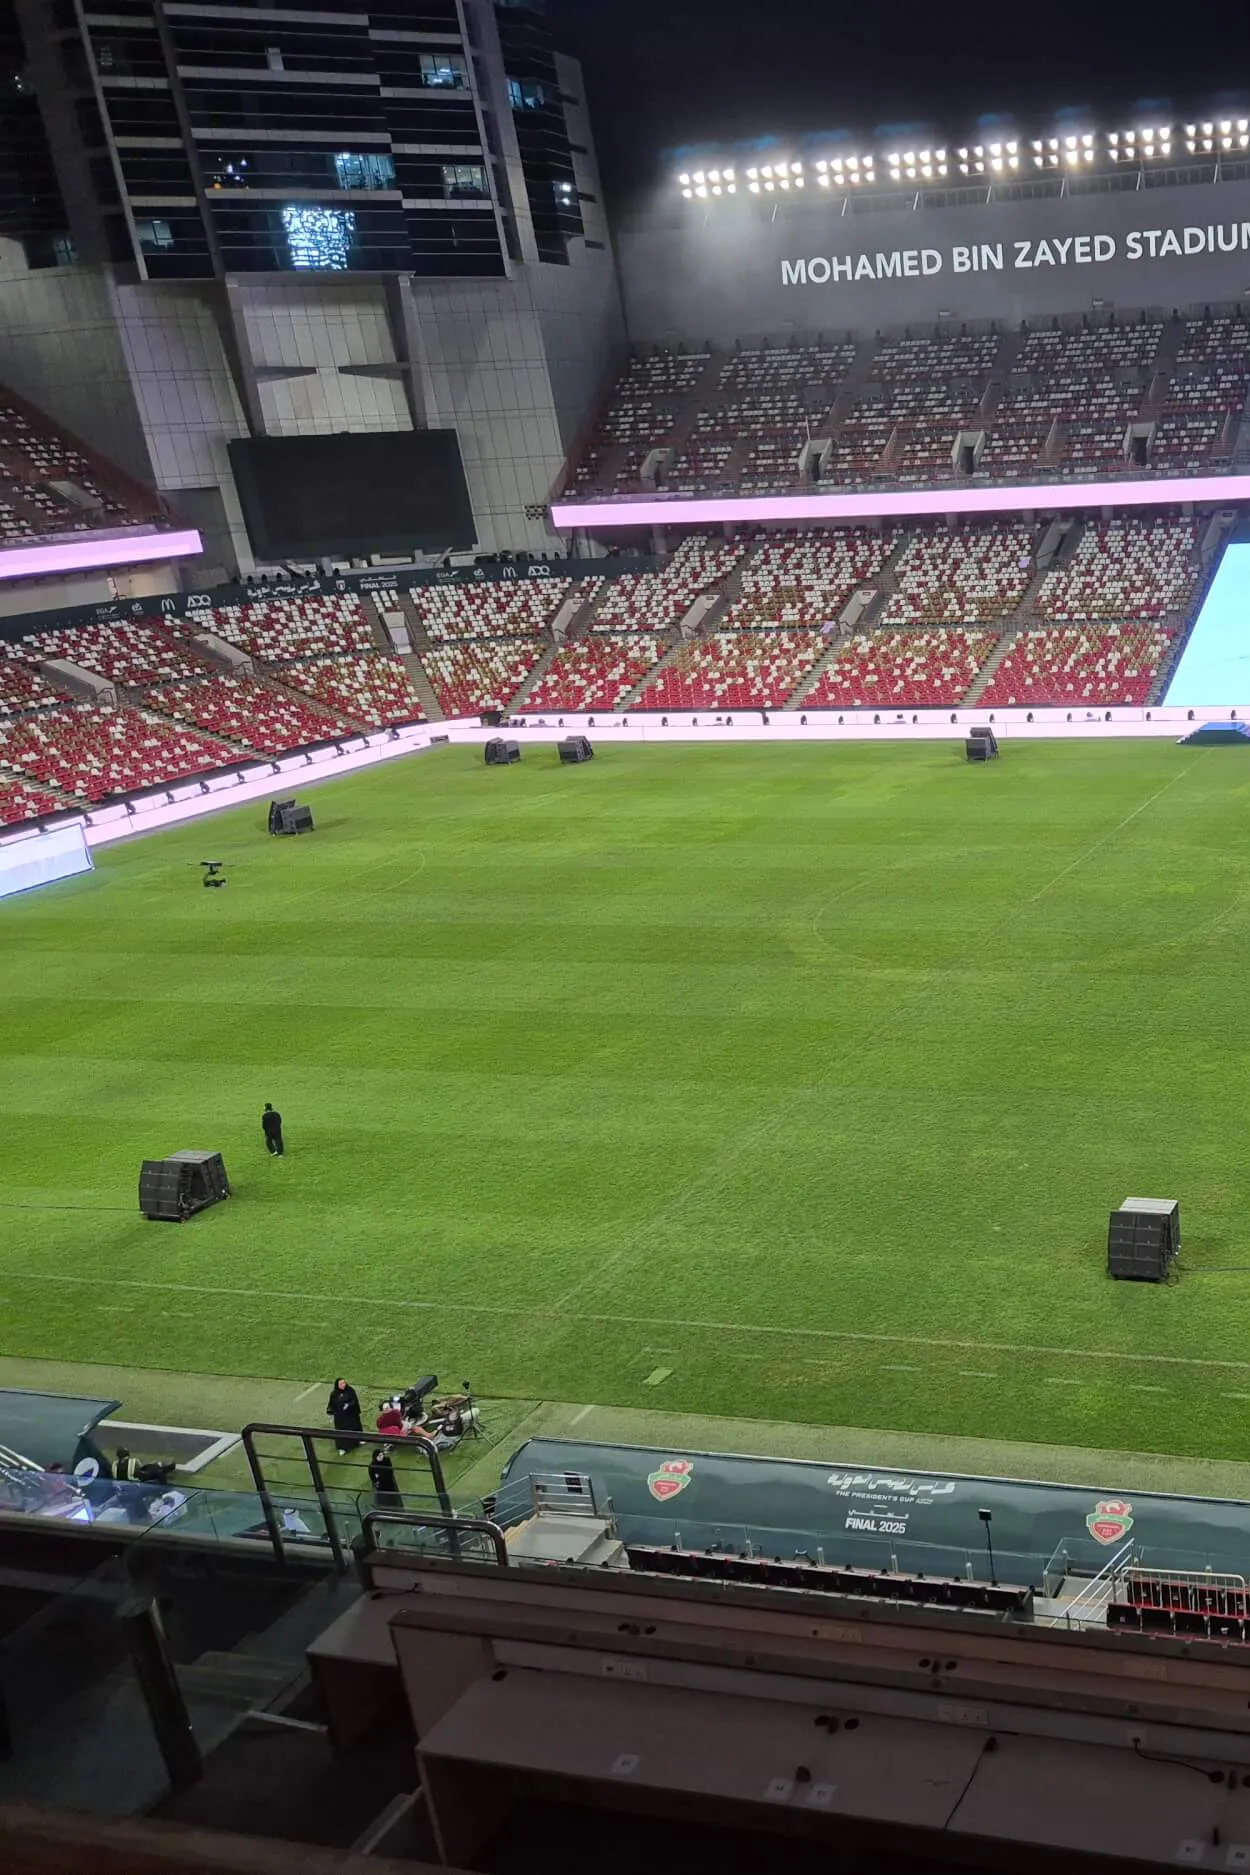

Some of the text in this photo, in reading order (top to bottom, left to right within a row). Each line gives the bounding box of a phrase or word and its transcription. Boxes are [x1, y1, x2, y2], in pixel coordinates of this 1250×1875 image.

[780, 248, 943, 286] MOHAMED
[952, 243, 1004, 273] BIN
[1013, 235, 1116, 268] ZAYED
[835, 1490, 850, 1498] THE
[845, 1517, 906, 1534] FINAL 2025
